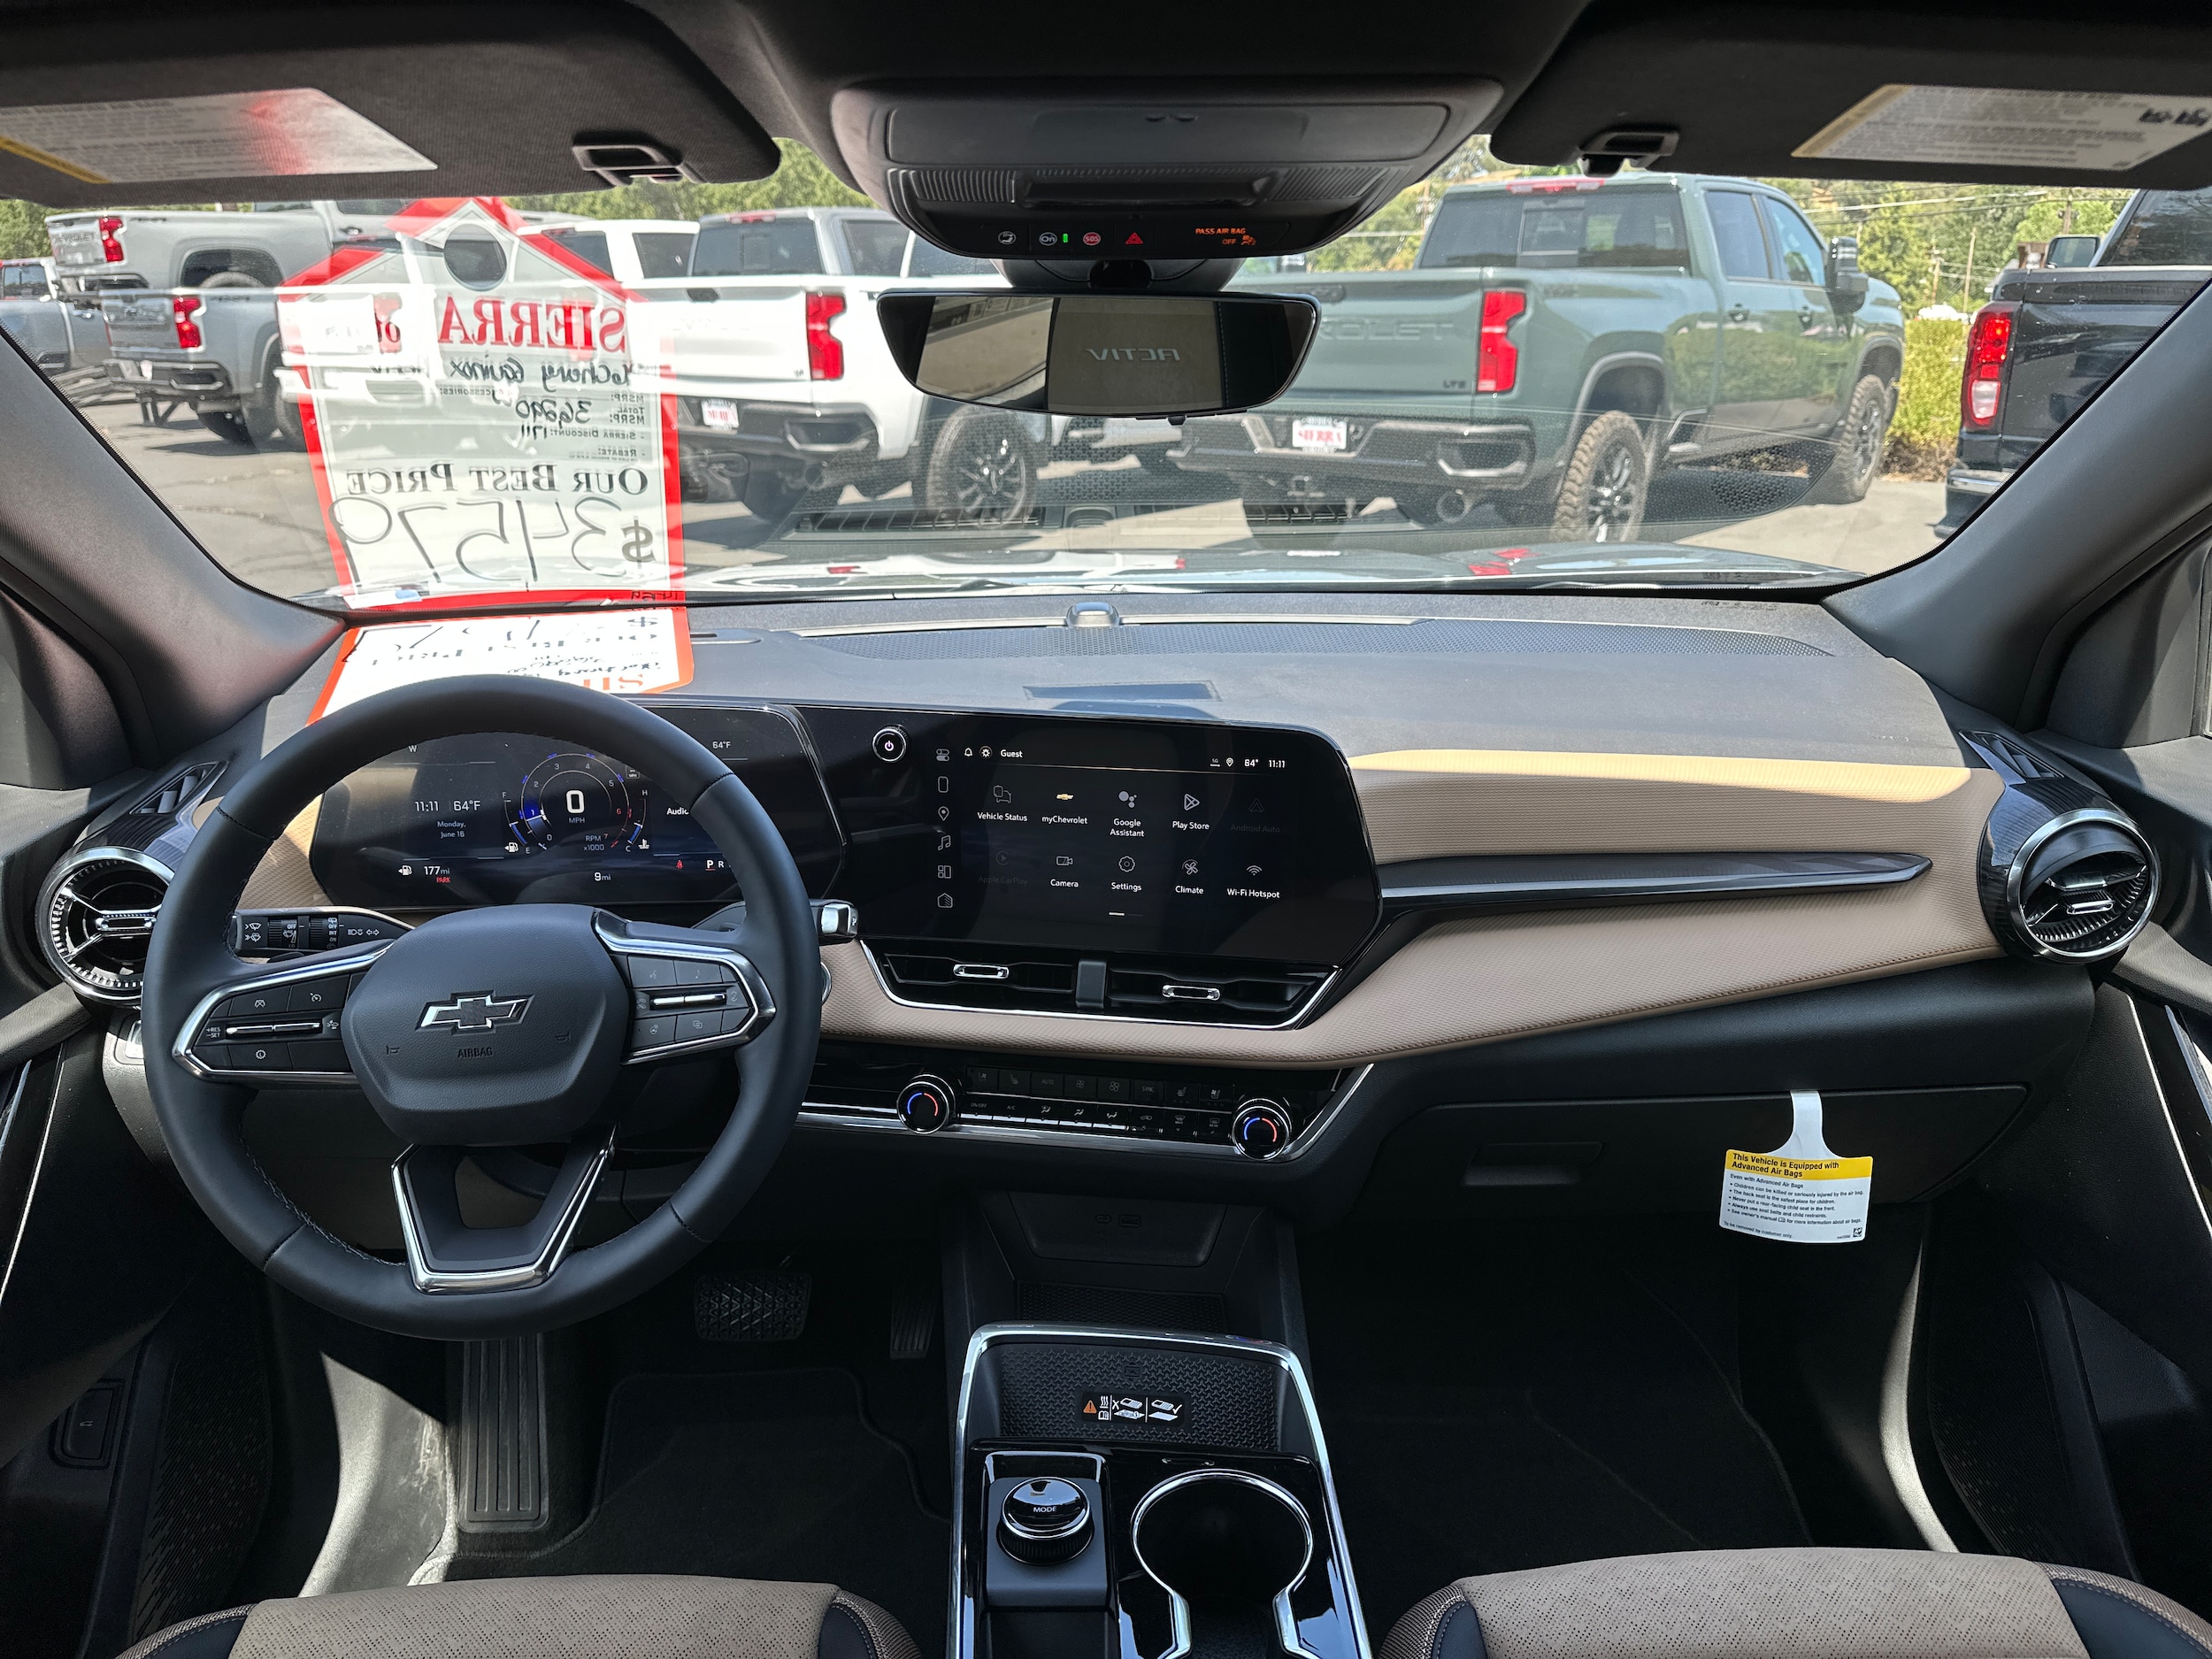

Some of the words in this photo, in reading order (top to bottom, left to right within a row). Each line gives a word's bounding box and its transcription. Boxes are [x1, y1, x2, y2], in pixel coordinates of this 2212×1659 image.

[408, 744, 418, 753] W
[712, 741, 732, 749] 64°F
[1000, 749, 1023, 758] Guest
[1268, 759, 1286, 768] 11:11
[415, 801, 439, 812] 11:11
[453, 800, 481, 811] 64°F
[565, 789, 585, 814] 0
[977, 811, 1003, 820] Vehicle
[1004, 812, 1028, 822] Status
[1041, 815, 1088, 825] myChevrolet
[1113, 818, 1141, 827] Google
[1172, 820, 1188, 831] Play
[1189, 821, 1210, 830] Store
[1110, 828, 1145, 837] Assistant
[1230, 824, 1261, 833] Android
[706, 859, 714, 868] P
[978, 875, 1000, 885] Apple
[1001, 877, 1028, 886] CarPlay
[1049, 878, 1079, 887] Camera
[1110, 881, 1142, 892] Settings
[1175, 885, 1204, 895] Climate
[1226, 887, 1248, 896] Wi-Fi
[1248, 889, 1280, 900] Hotspot
[457, 1047, 493, 1059] AIRBAG
[1733, 1152, 1748, 1162] This
[1751, 1156, 1778, 1166] Vehicle
[1788, 1161, 1823, 1171] Equipped
[1732, 1161, 1769, 1173] Advanced
[1784, 1169, 1803, 1178] Bags
[1756, 1178, 1781, 1187] Advanced
[1760, 1201, 1786, 1210] rear-facing
[1736, 1224, 1755, 1233] removed
